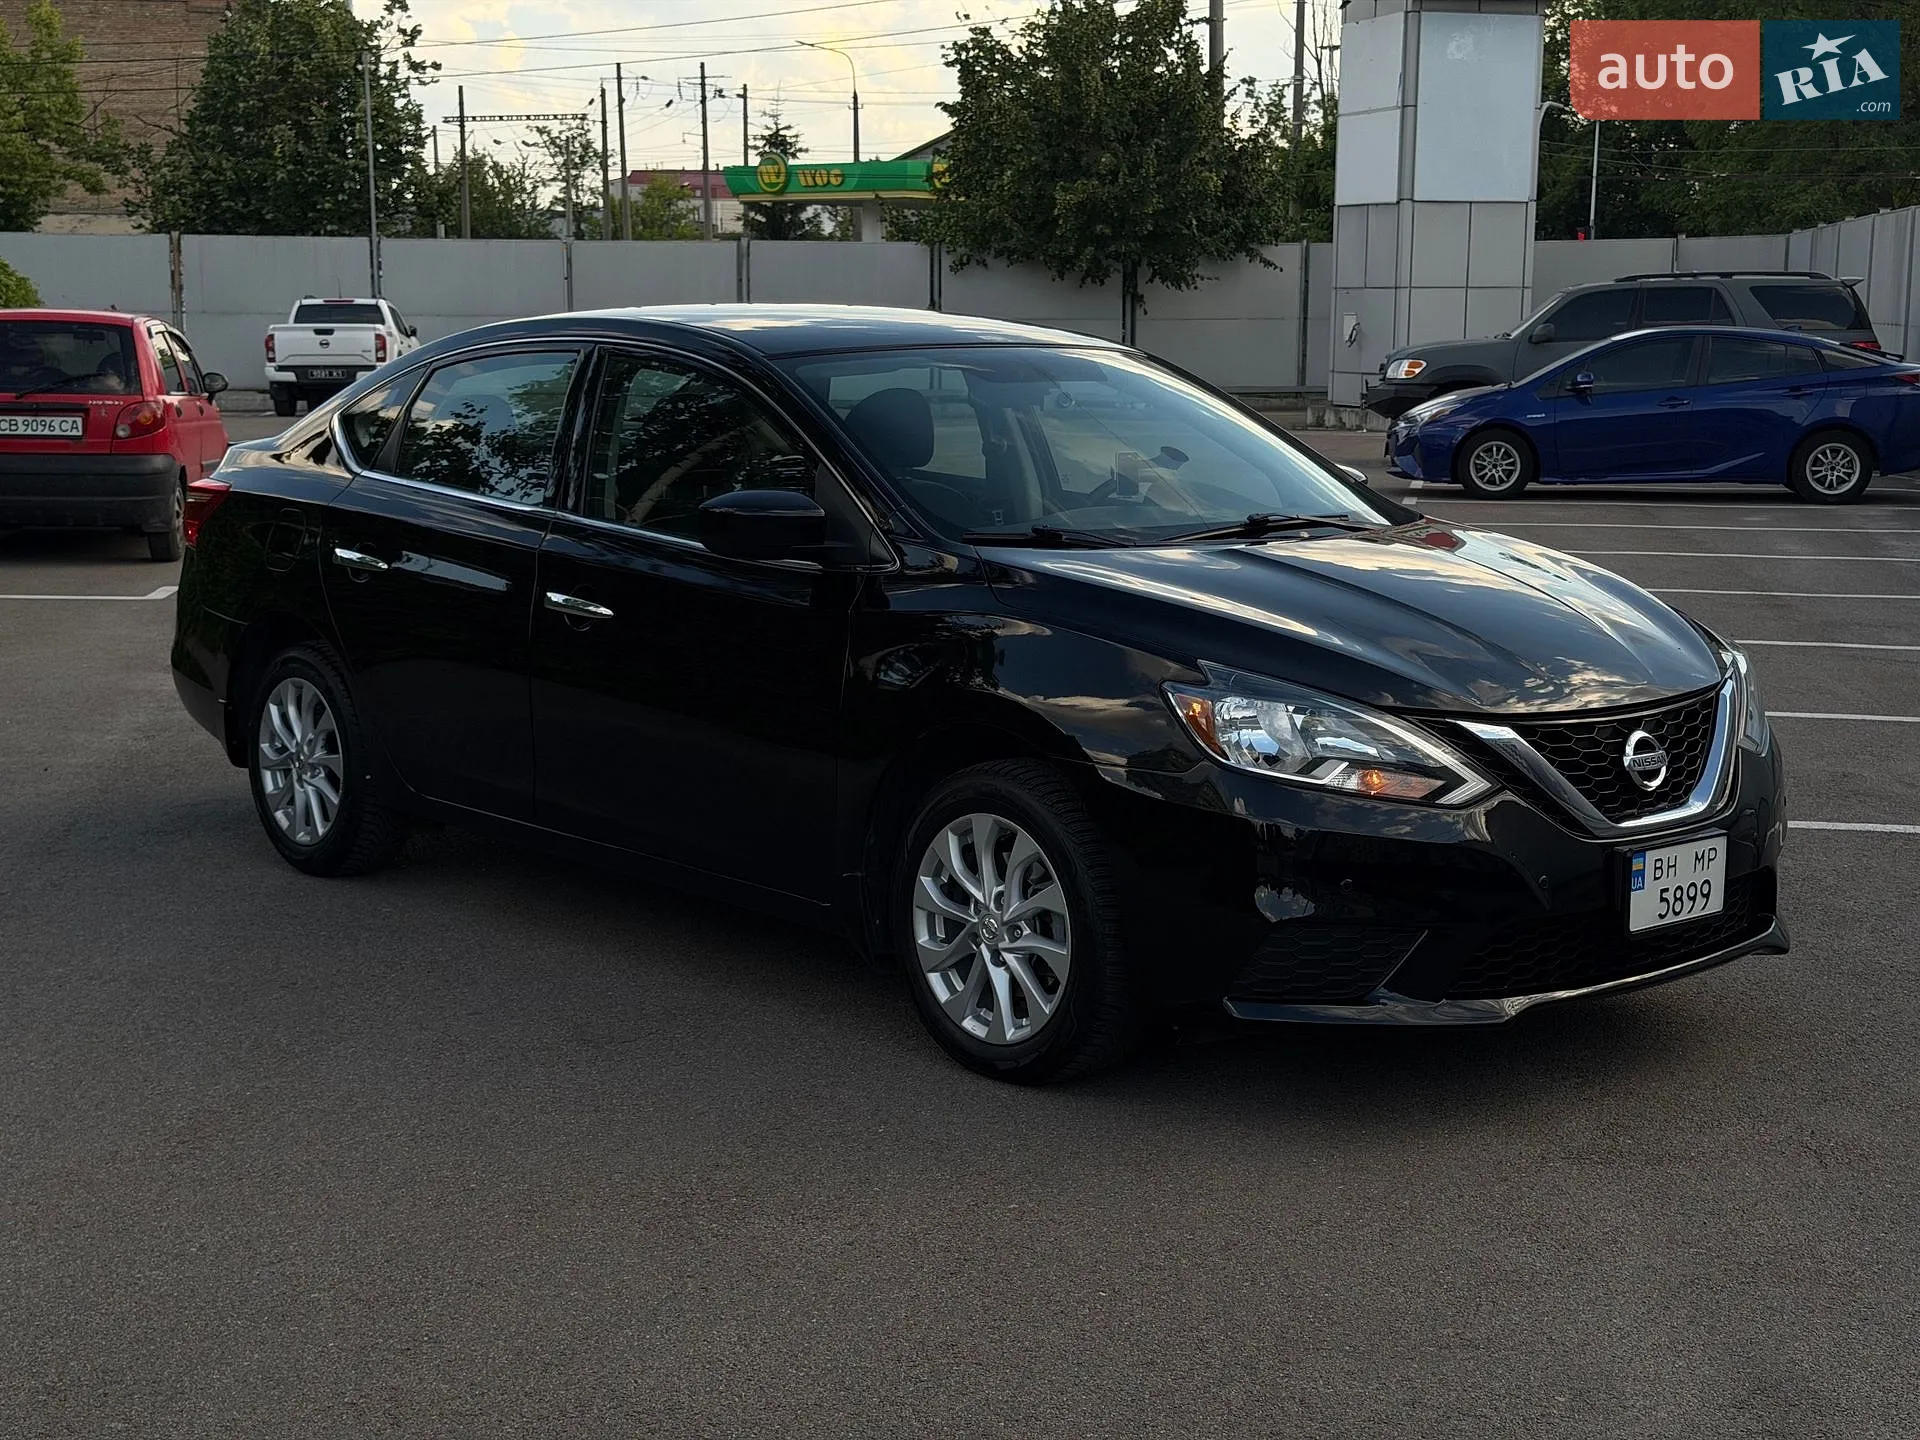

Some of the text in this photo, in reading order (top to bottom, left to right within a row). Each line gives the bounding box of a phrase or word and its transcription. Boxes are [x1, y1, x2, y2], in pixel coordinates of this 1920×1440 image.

[797, 168, 844, 187] WOG
[22, 418, 56, 433] 9096
[59, 419, 80, 433] CA
[1632, 752, 1666, 767] NISSAN
[1653, 847, 1718, 881] BH MP
[1631, 876, 1643, 890] UA
[1657, 878, 1712, 920] 5899
